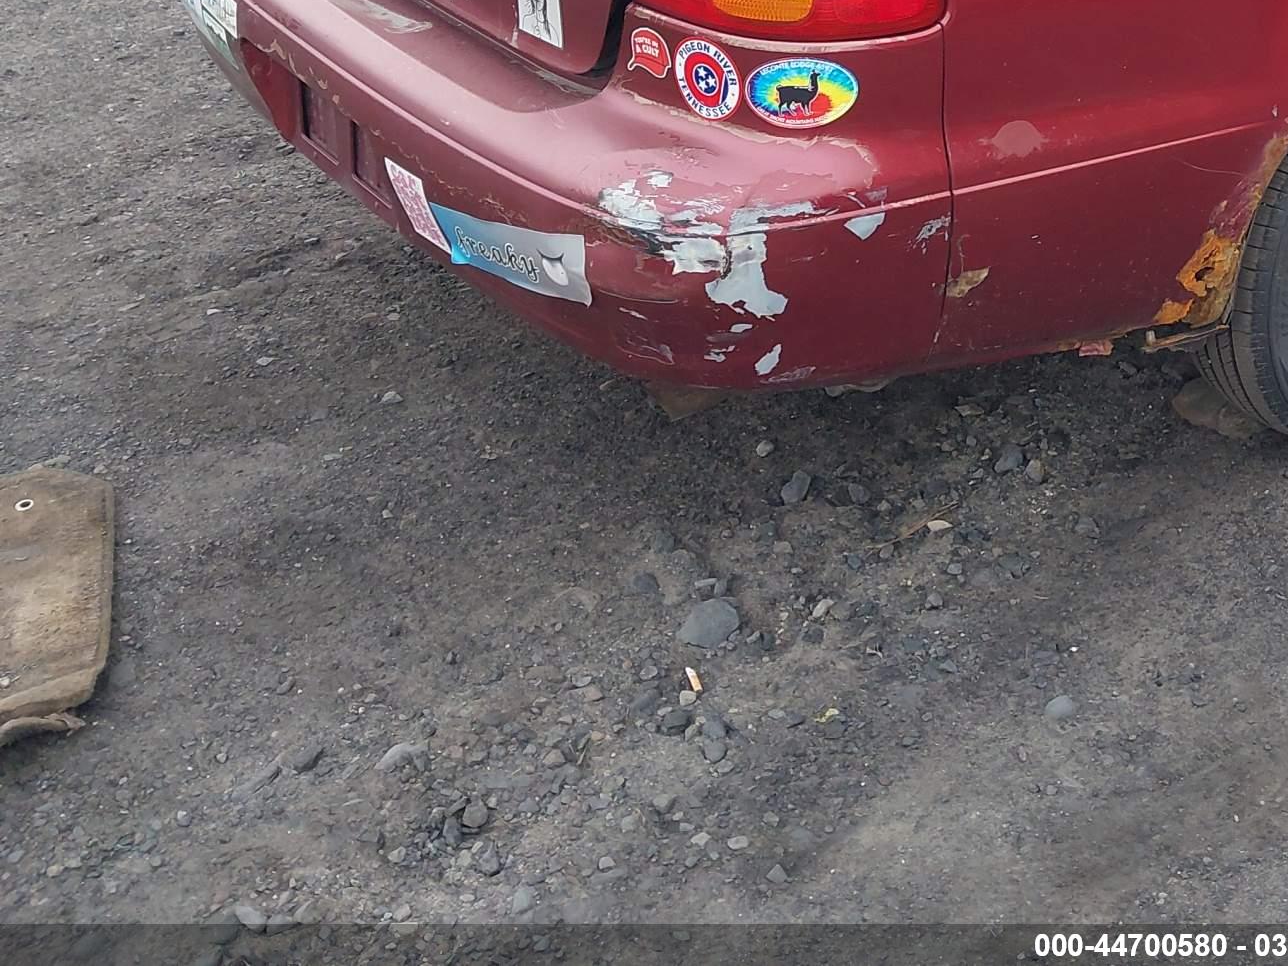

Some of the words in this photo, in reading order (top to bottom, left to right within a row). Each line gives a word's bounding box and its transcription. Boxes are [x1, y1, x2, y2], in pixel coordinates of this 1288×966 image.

[635, 44, 642, 53] A
[642, 44, 659, 58] CULT
[679, 41, 711, 60] PIGEON
[713, 50, 737, 86] RIVER
[678, 77, 732, 118] TENNESSEE
[454, 226, 539, 282] freaky
